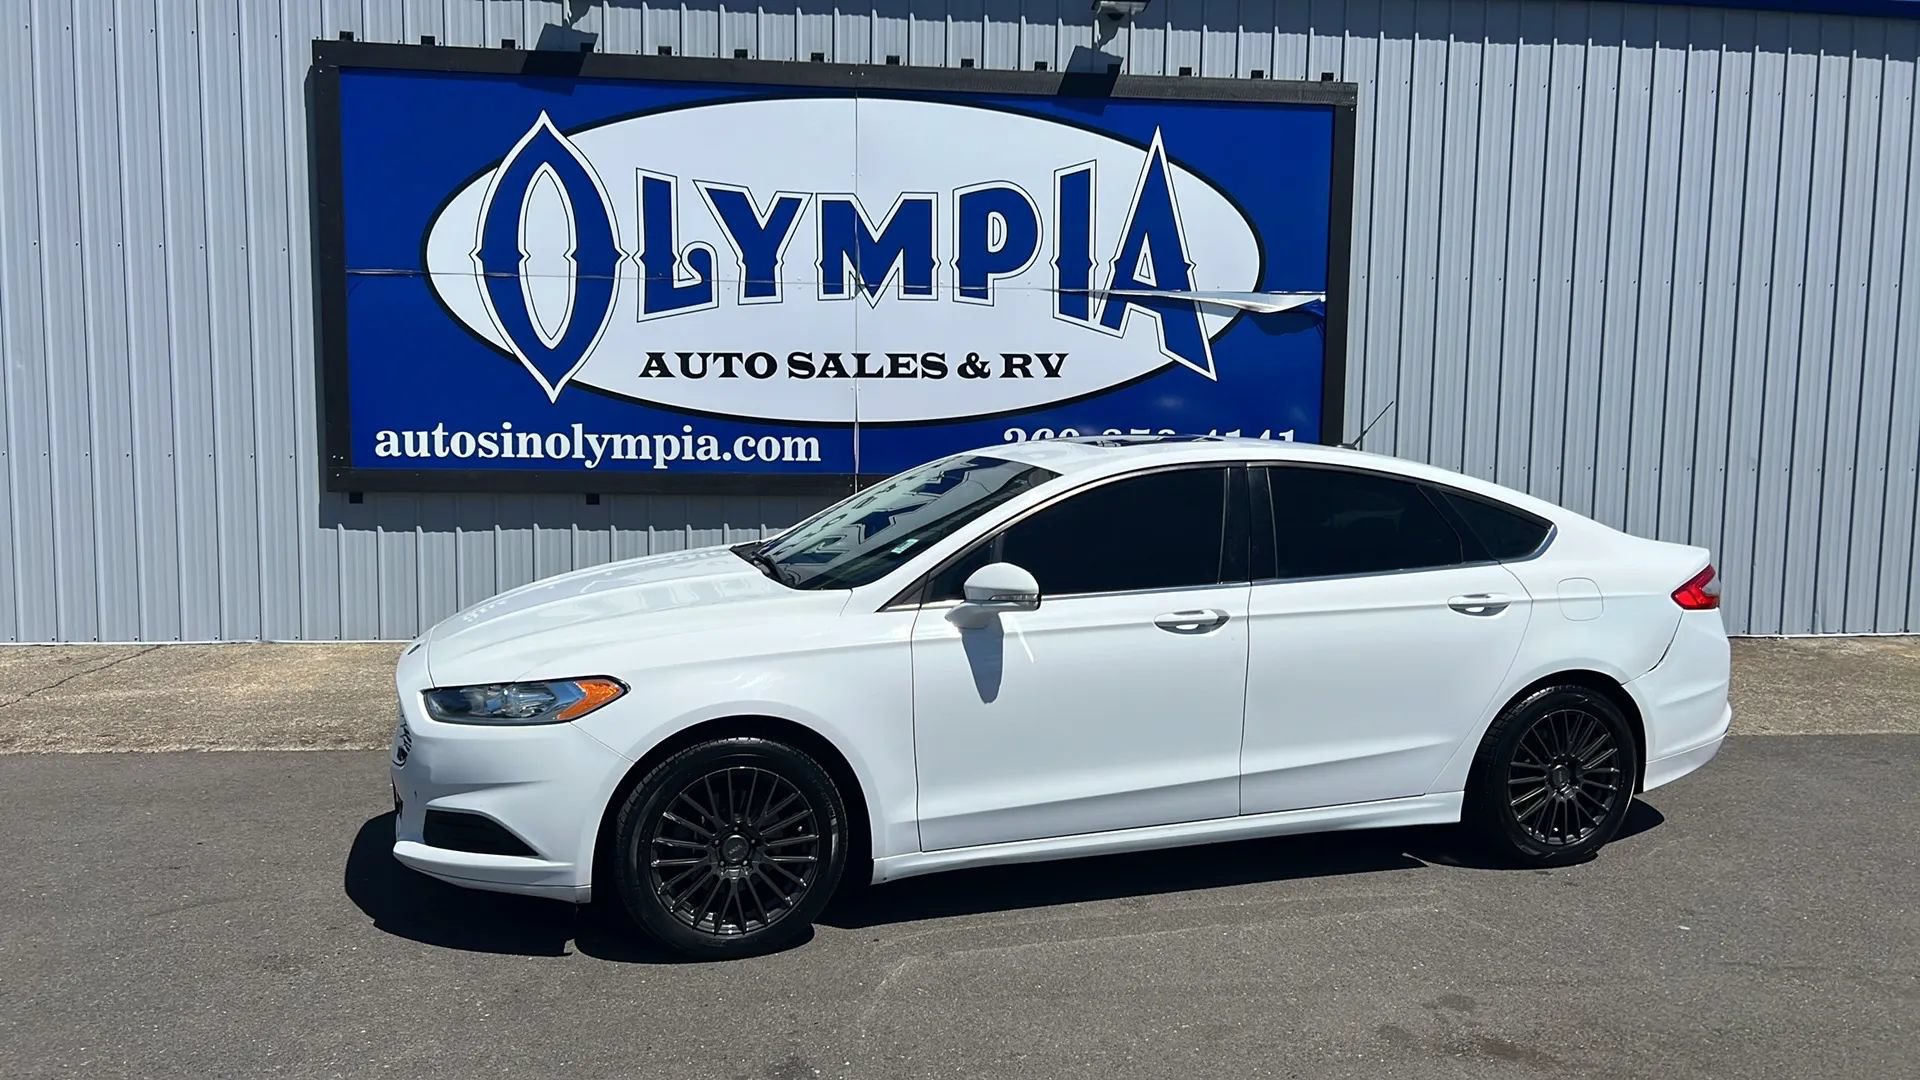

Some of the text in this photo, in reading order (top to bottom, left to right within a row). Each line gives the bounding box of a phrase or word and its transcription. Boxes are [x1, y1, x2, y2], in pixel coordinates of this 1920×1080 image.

[470, 110, 1217, 404] OLYMPIA
[638, 351, 1069, 380] AUTO SALES & RV
[374, 421, 822, 470] autosinolympia.com
